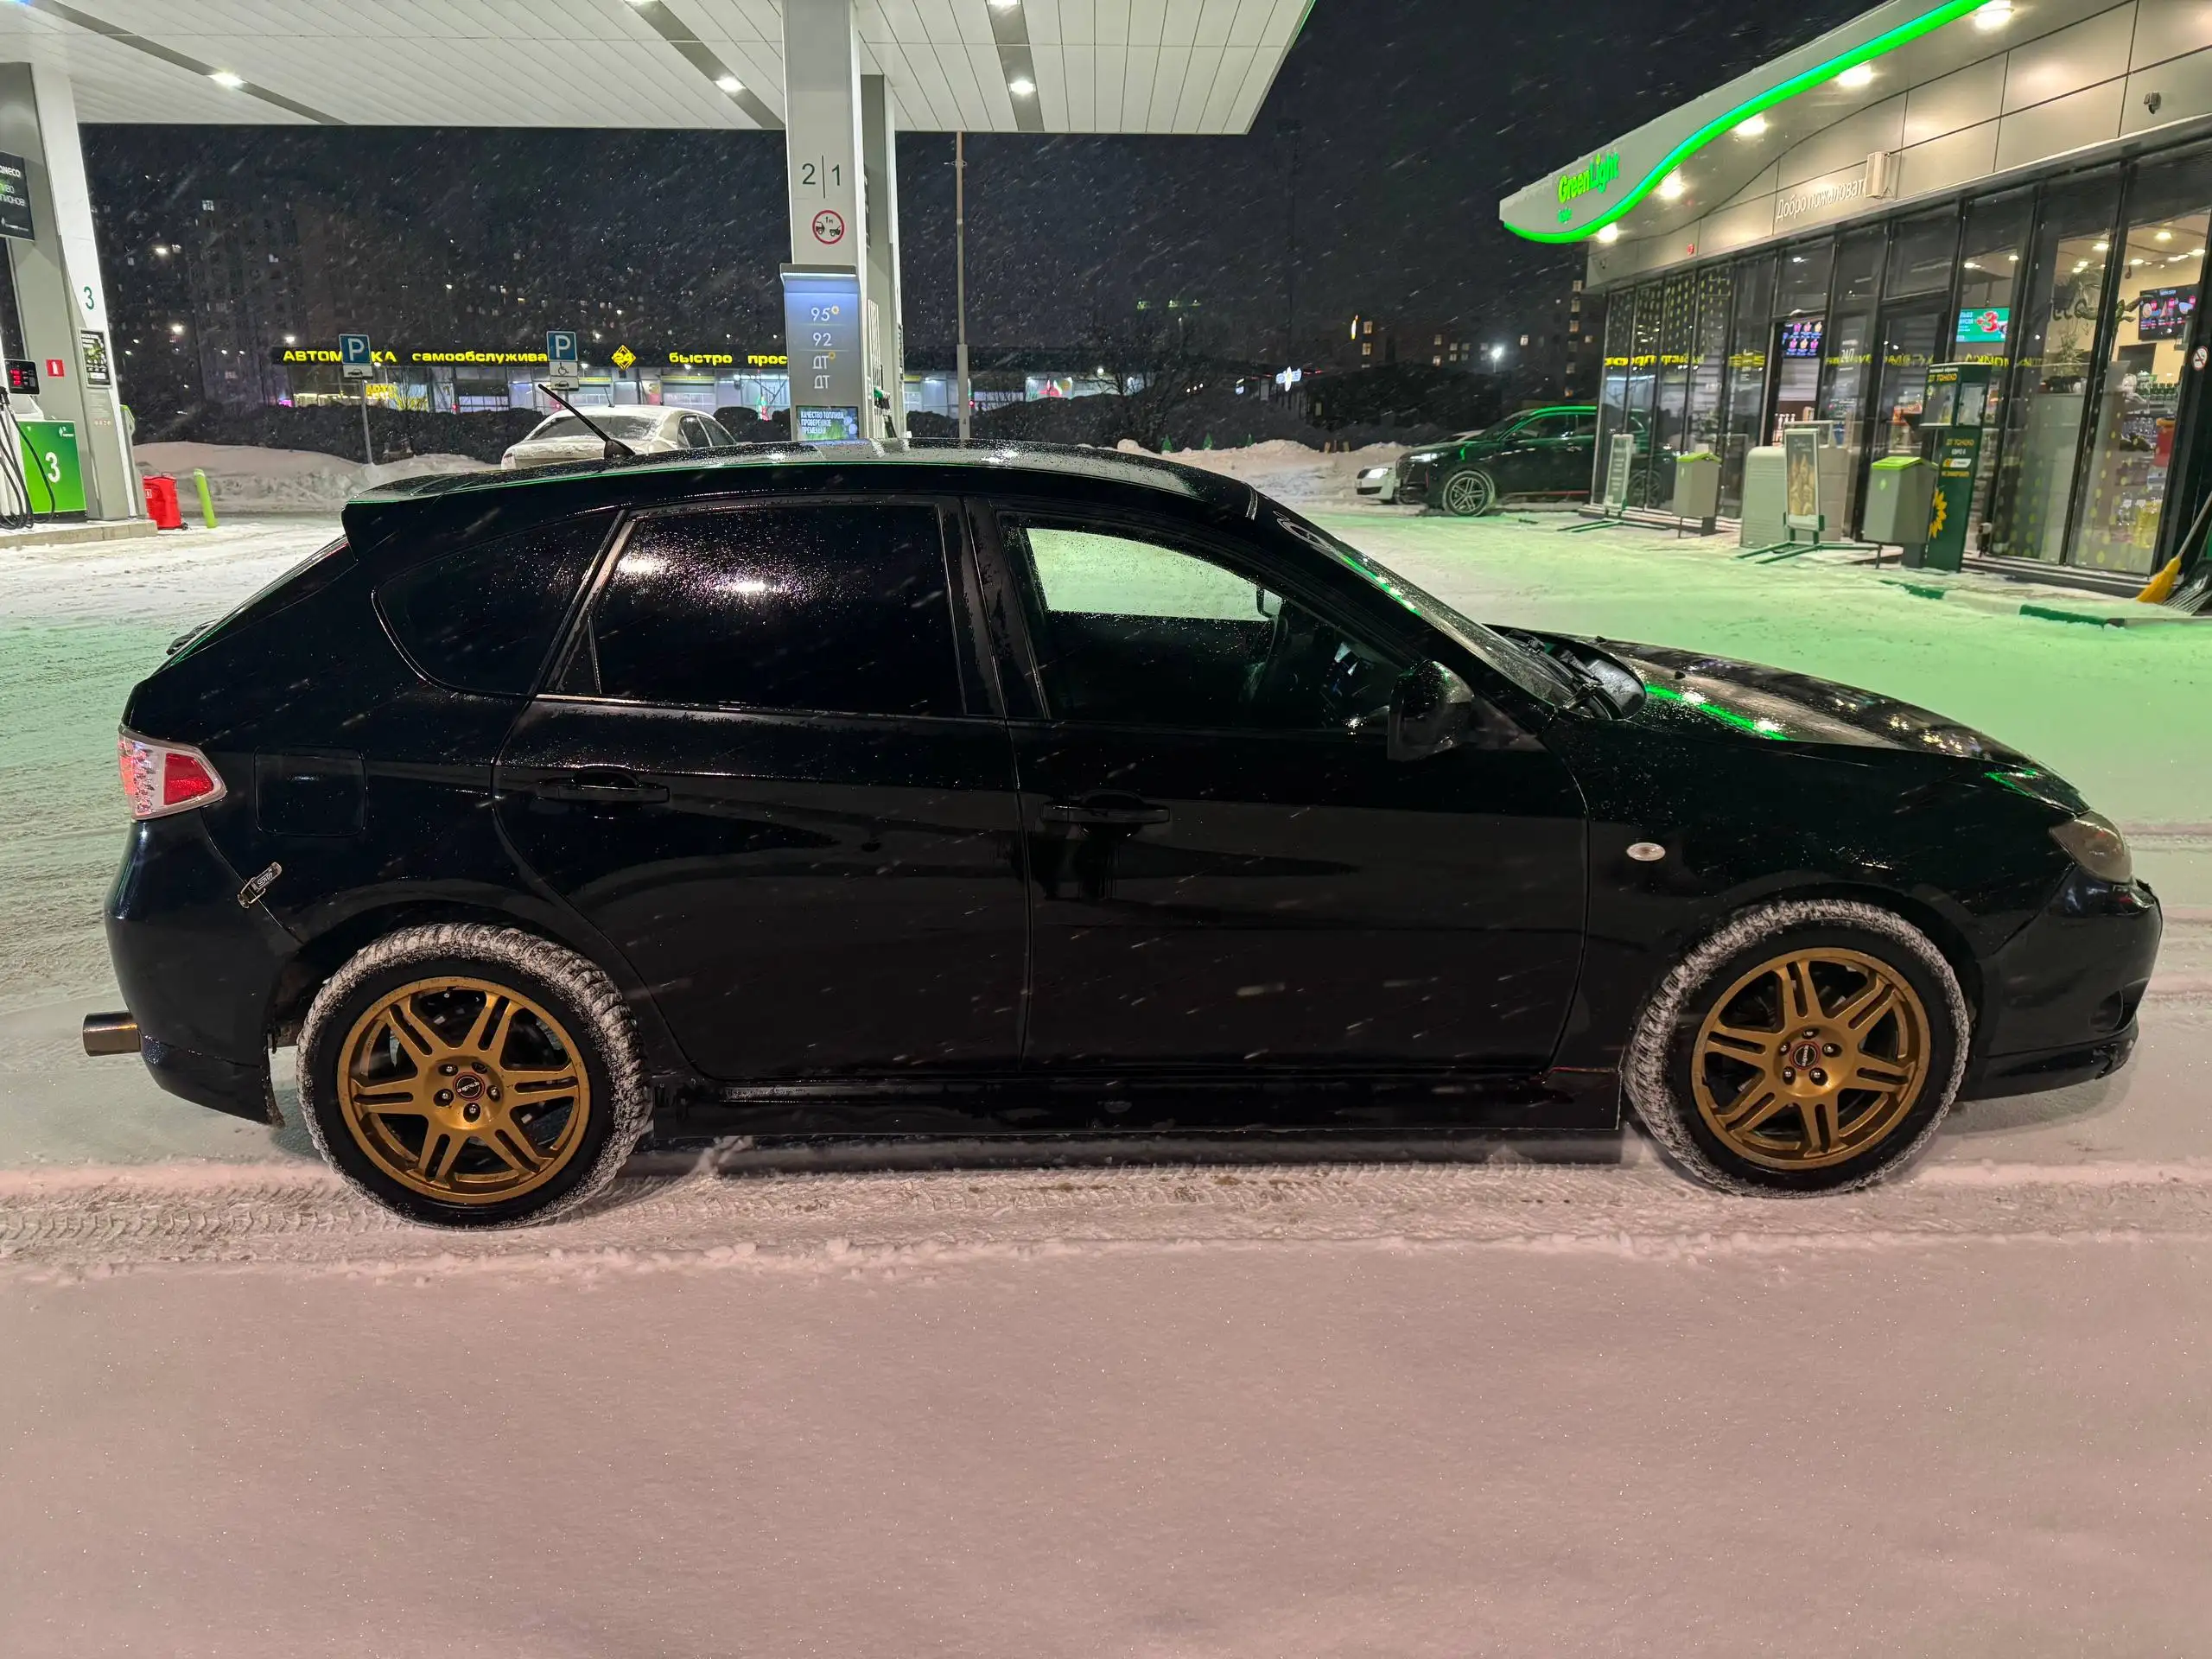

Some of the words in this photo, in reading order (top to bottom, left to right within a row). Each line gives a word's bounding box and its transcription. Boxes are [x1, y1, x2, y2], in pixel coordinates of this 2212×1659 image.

[802, 162, 816, 185] 2
[832, 163, 841, 186] 1
[1559, 151, 1619, 203] GreenLight
[1776, 194, 1807, 222] Добро
[84, 286, 95, 310] 3
[810, 307, 830, 321] 95
[347, 338, 365, 361] P
[555, 334, 571, 358] P
[812, 332, 833, 346] 92
[283, 350, 397, 363] АВТОМКА
[411, 351, 550, 364] самообслужива
[669, 353, 733, 365] быстро
[812, 355, 830, 369] ДТ
[814, 375, 830, 389] ДТ
[45, 452, 60, 483] 3
